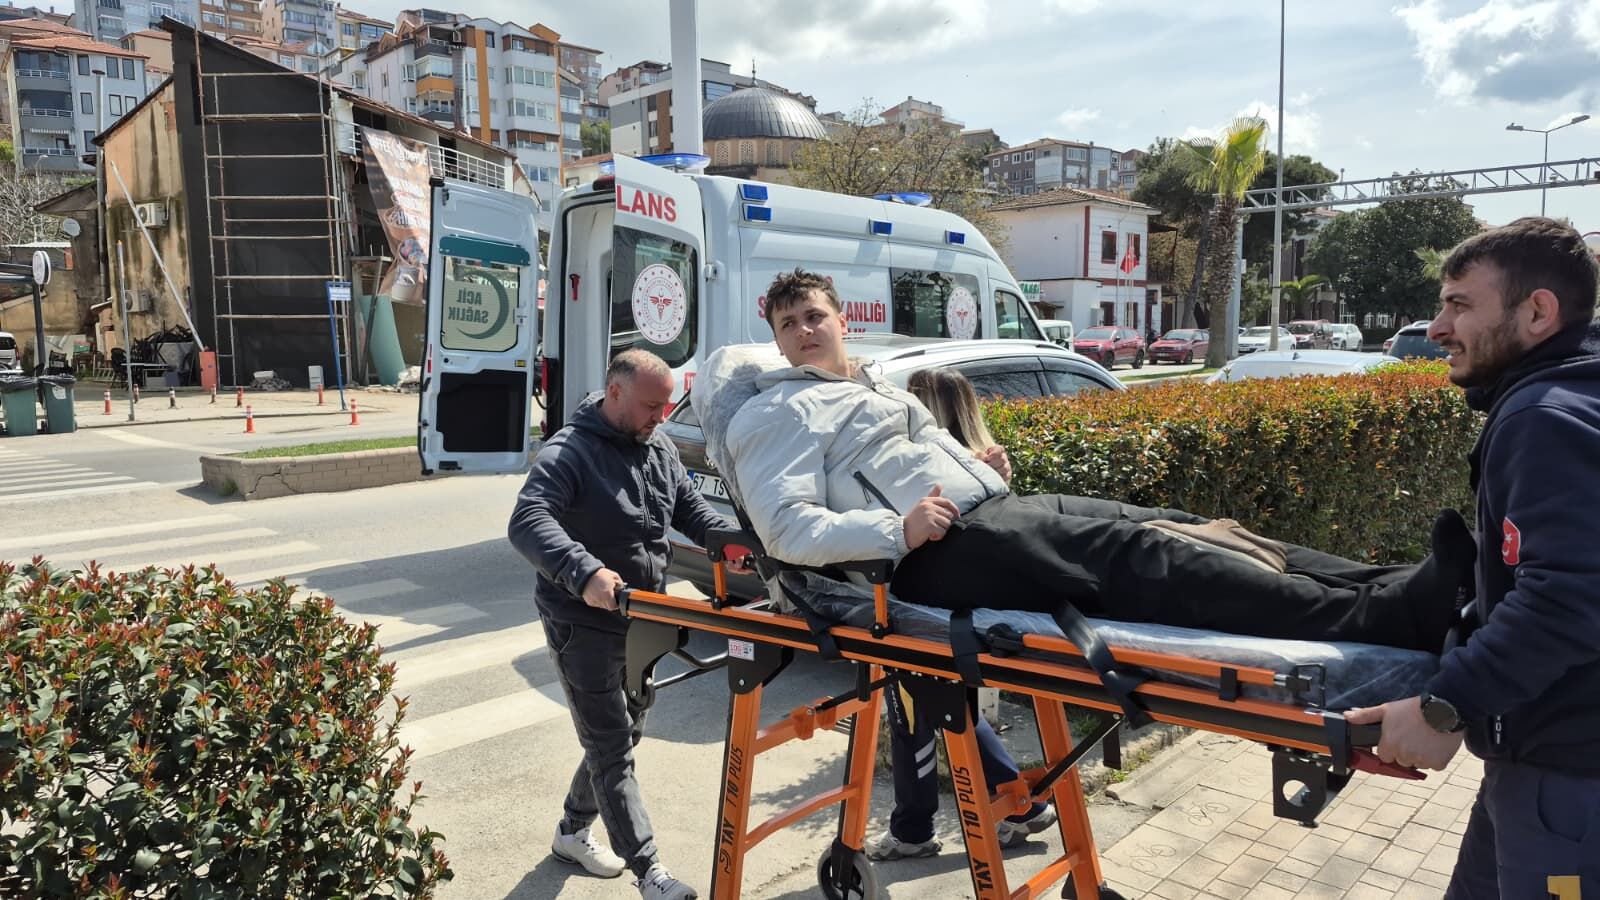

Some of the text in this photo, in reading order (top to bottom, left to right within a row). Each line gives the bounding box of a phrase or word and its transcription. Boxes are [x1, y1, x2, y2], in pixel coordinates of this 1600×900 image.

[616, 185, 677, 223] LANS
[840, 300, 886, 323] ANLIĞI
[693, 475, 706, 491] 67
[721, 817, 735, 846] TAY
[729, 744, 744, 780] PLUS
[953, 765, 976, 805] PLUS
[973, 857, 994, 891] TAY
